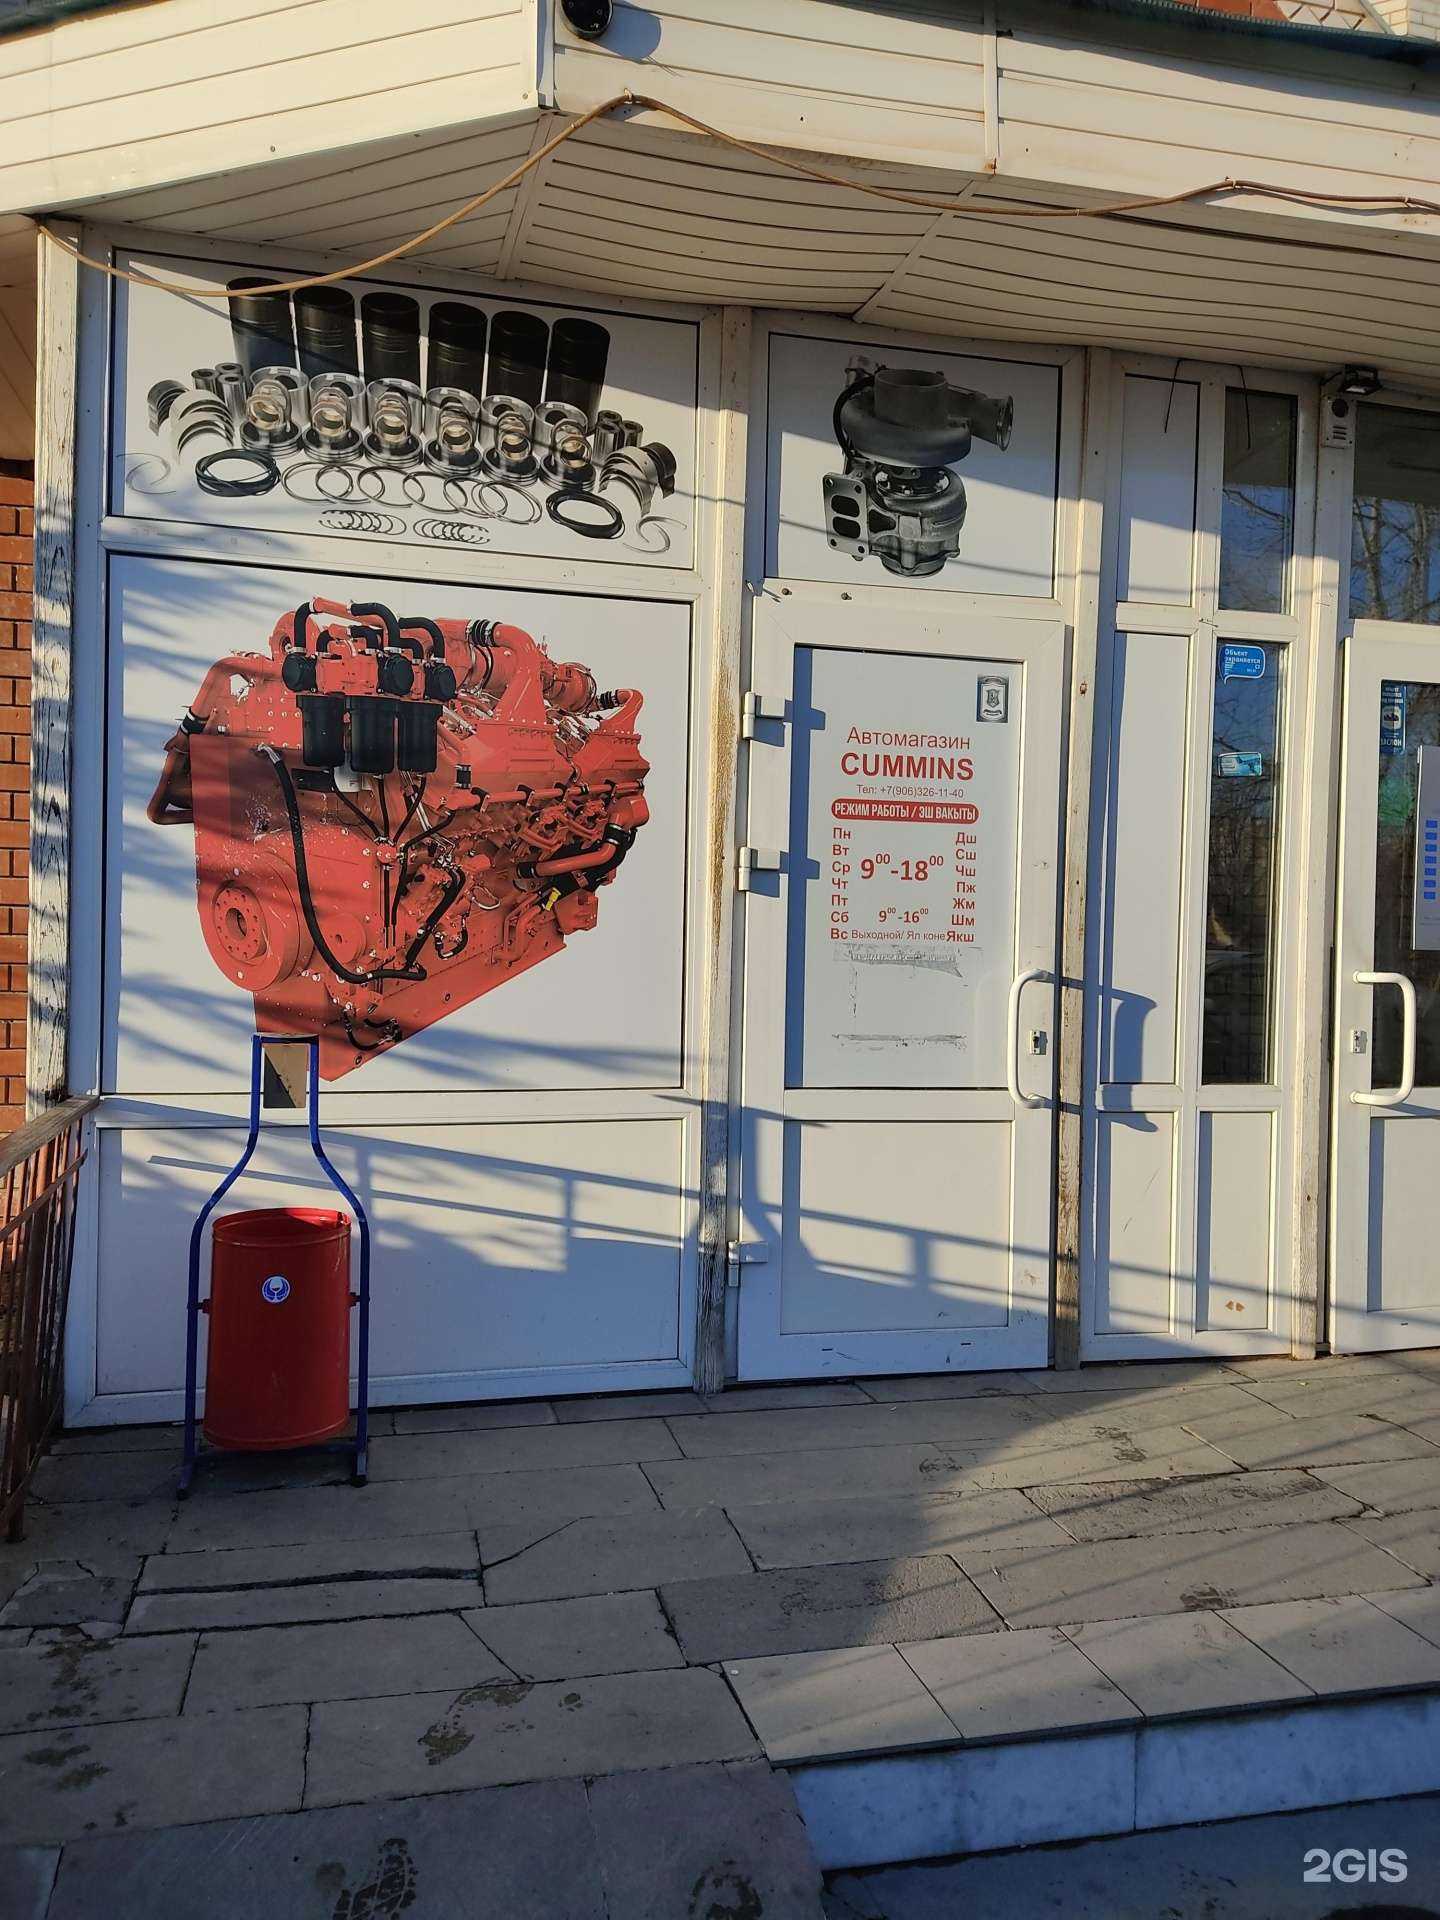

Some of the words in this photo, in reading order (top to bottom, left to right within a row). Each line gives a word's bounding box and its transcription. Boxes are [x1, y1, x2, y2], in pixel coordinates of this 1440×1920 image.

[846, 726, 971, 750] Автомагазин
[841, 752, 974, 781] CUMMINS
[857, 784, 877, 795] Тел:
[880, 785, 964, 799] +7(906)326-11-40
[834, 802, 870, 817] РЕЖИМ
[871, 803, 909, 818] РАБОТЫ
[910, 807, 917, 818] /
[918, 805, 935, 819] ЭШ
[936, 806, 976, 821] ВАКЫТЫ
[833, 827, 851, 839] Пн
[955, 832, 977, 846] Дш
[832, 844, 849, 856] Вт
[955, 848, 977, 861] Сш
[832, 861, 850, 875] Ср
[955, 865, 976, 877] Чш
[832, 878, 848, 890] Чт
[956, 881, 976, 894] Пж
[831, 894, 848, 906] Пт
[953, 897, 975, 910] Жм
[831, 911, 849, 923] Сб
[951, 914, 975, 927] Шм
[830, 928, 848, 940] Вс
[946, 931, 974, 942] Якш
